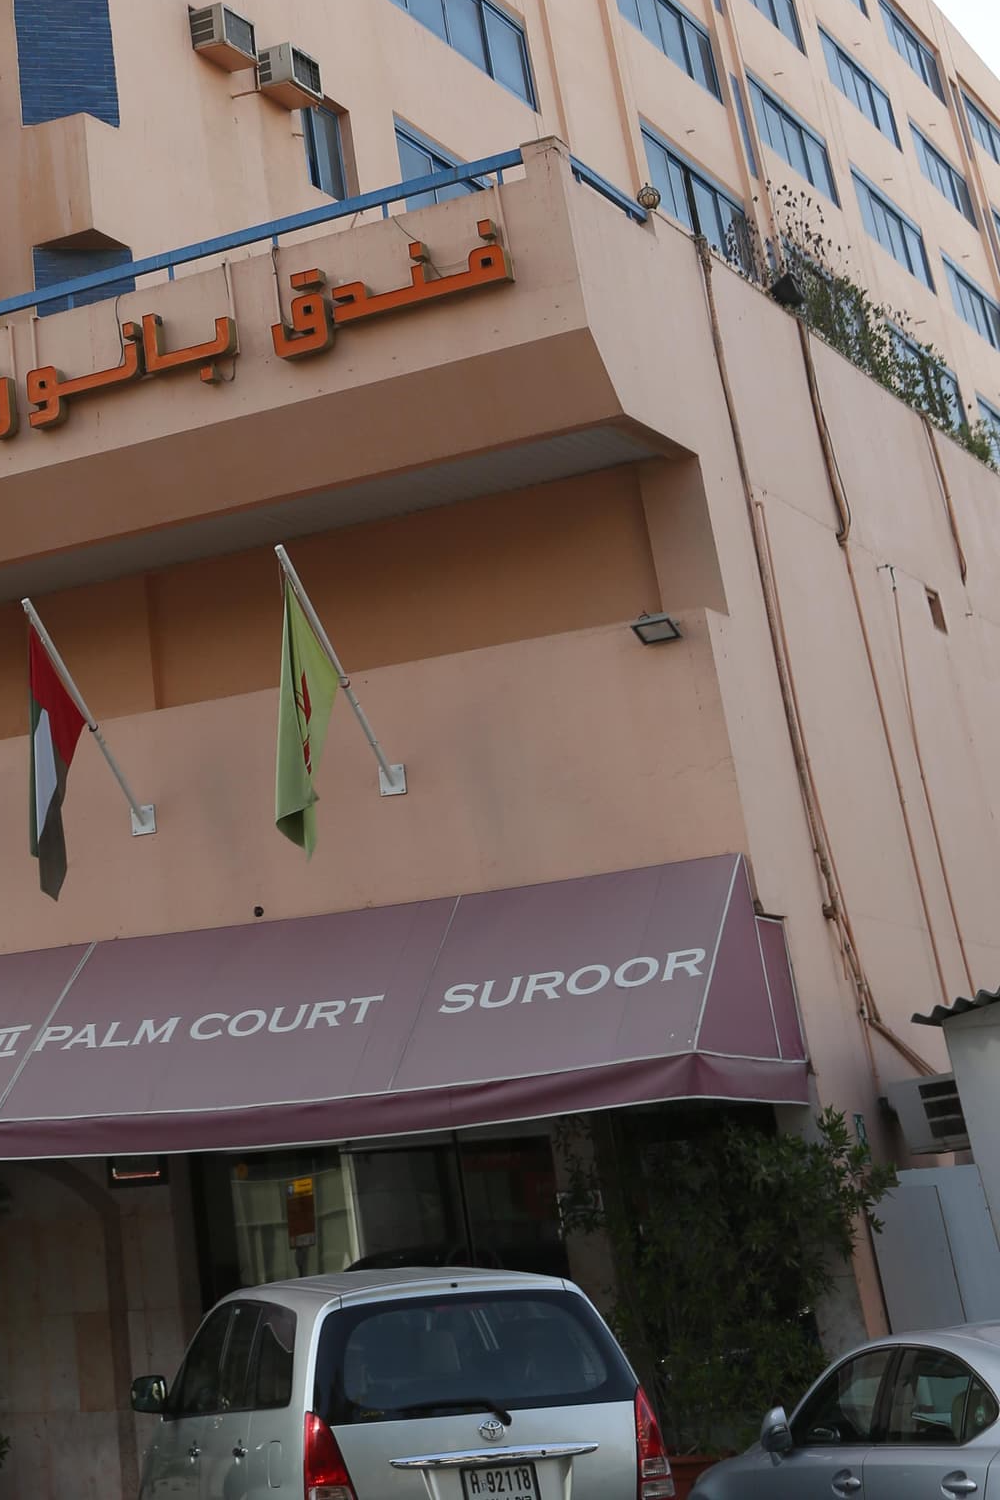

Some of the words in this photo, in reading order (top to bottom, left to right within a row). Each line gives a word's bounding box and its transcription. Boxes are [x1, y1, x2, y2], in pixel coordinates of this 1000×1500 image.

[272, 218, 516, 361] فندق
[437, 948, 706, 1014] SUROOR
[34, 1016, 180, 1053] PALM
[189, 994, 385, 1041] COURT
[486, 1467, 532, 1494] 92118
